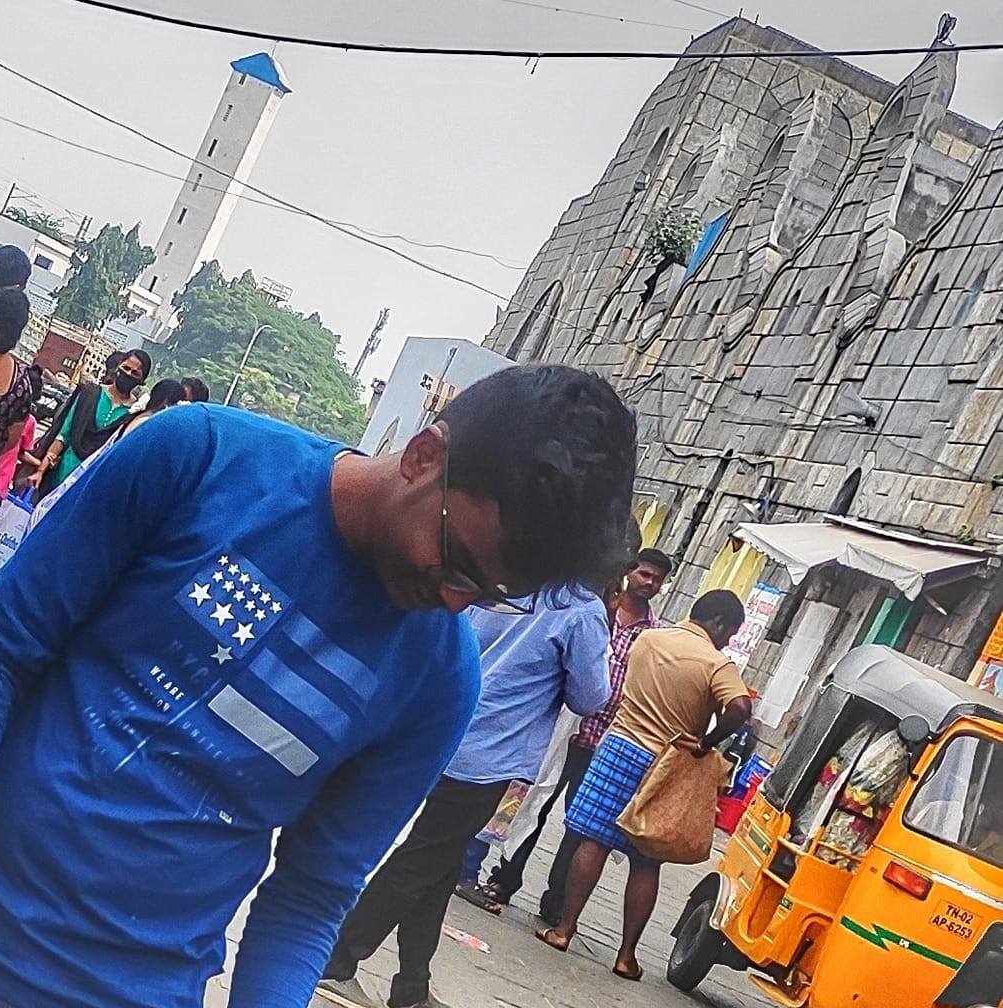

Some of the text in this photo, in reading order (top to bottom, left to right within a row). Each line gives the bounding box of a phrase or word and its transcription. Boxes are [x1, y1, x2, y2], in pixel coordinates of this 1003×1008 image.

[149, 665, 184, 700] WE ARE
[945, 904, 974, 925] TN-02
